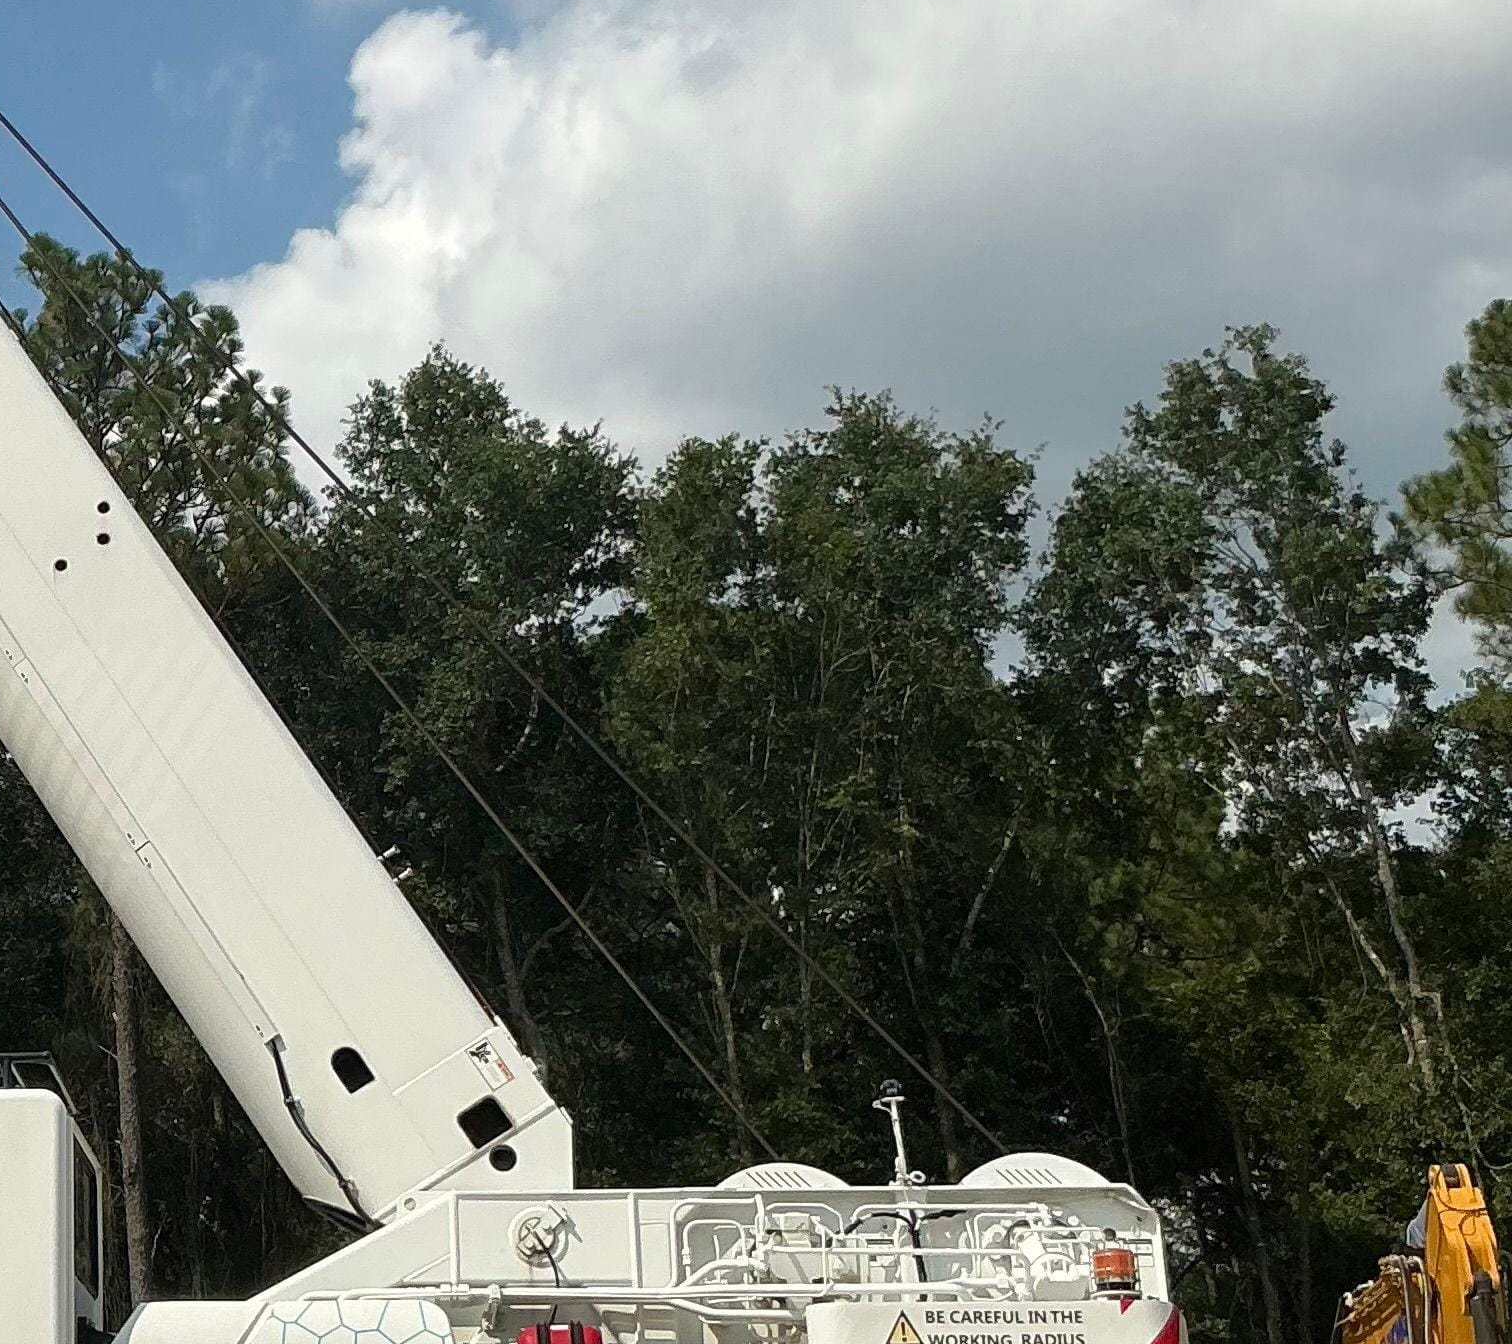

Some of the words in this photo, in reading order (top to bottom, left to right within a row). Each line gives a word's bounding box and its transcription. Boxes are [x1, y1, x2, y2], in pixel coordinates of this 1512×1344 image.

[924, 1310, 945, 1324] BE
[949, 1310, 1024, 1324] CAREFUL
[1028, 1310, 1048, 1324] IN
[1049, 1310, 1084, 1324] THE
